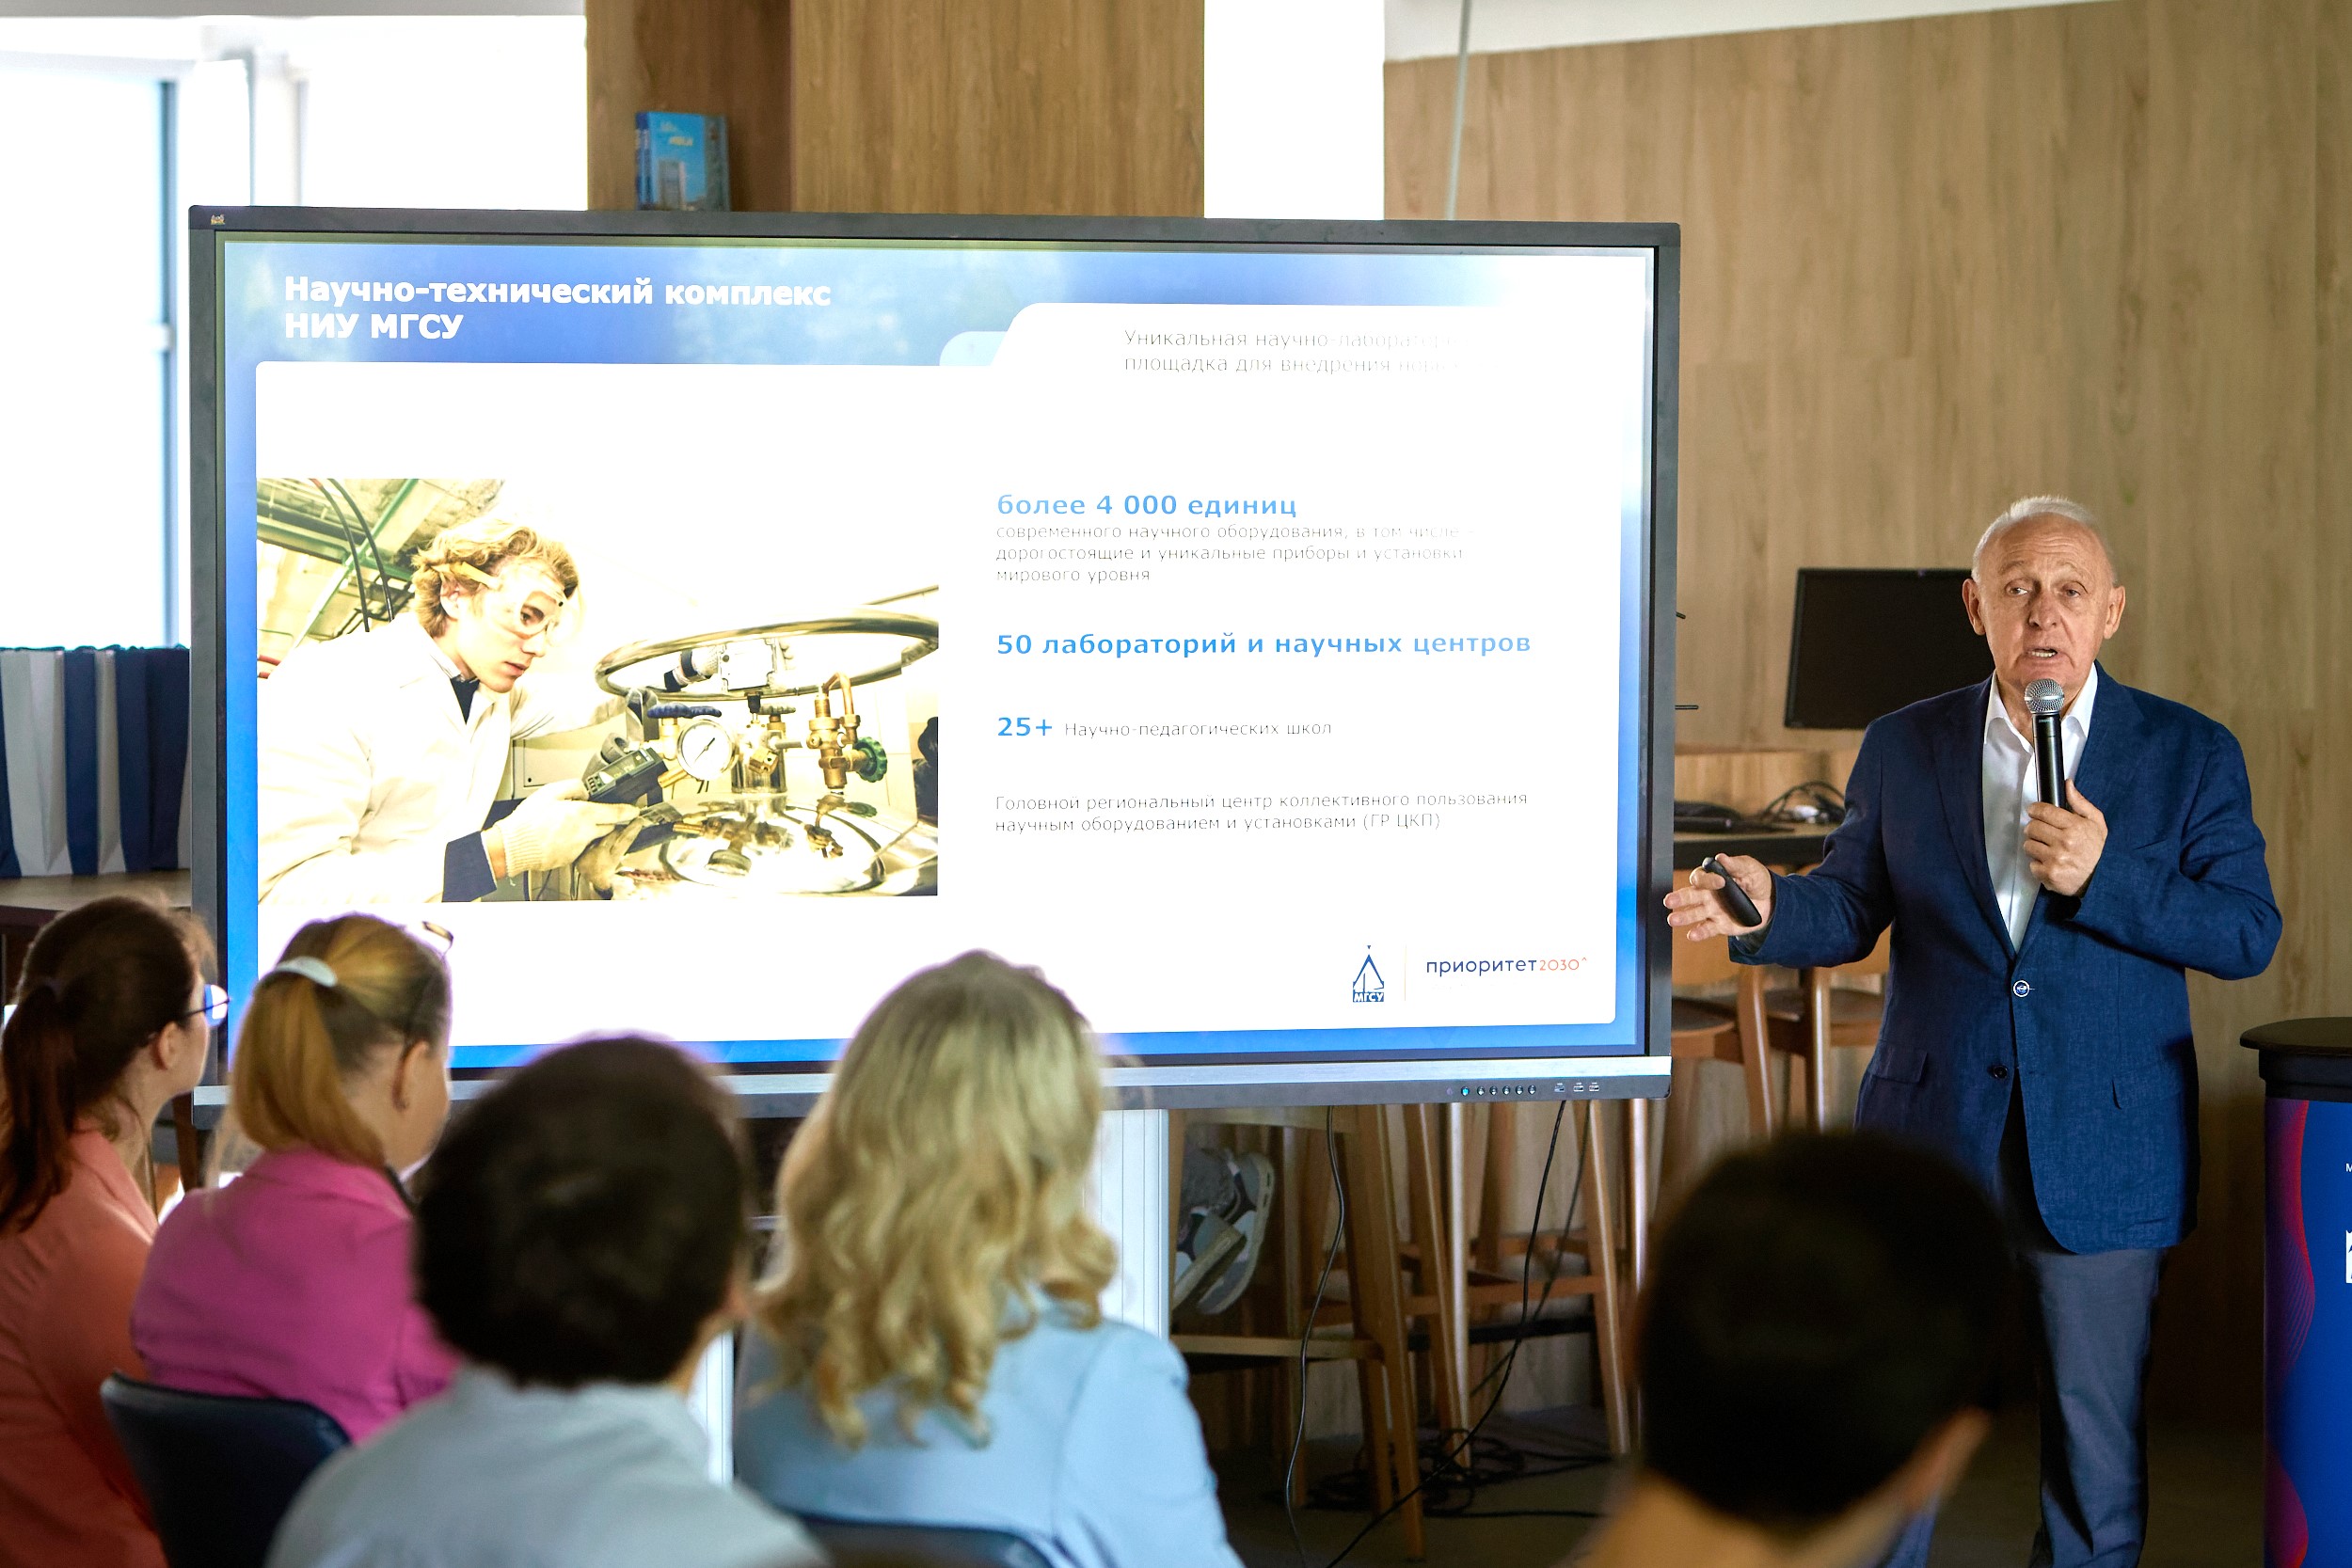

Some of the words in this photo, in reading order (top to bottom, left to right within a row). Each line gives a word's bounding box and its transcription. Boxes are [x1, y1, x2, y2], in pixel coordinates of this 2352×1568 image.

[285, 276, 653, 309] Научно-технический
[665, 284, 832, 307] комплекс
[285, 313, 359, 339] НИУ
[371, 313, 464, 340] МГСУ
[1124, 329, 1248, 347] Уникальная
[1125, 357, 1228, 374] площадка
[1235, 358, 1272, 373] для
[1281, 359, 1391, 375] внедрения
[997, 494, 1086, 515] более
[1096, 495, 1113, 515] 4
[1123, 494, 1177, 515] 000
[1187, 499, 1297, 519] единиц
[996, 527, 1121, 542] современного
[1129, 527, 1211, 541] научного
[1217, 524, 1349, 542] оборудования,
[1357, 527, 1365, 538] в
[1374, 527, 1402, 538] том
[1409, 527, 1459, 538] числе
[995, 548, 1134, 563] дорогостоящие
[1141, 548, 1151, 560] и
[1158, 548, 1266, 563] уникальные
[1273, 545, 1349, 562] приборы
[1357, 548, 1366, 560] и
[1374, 548, 1463, 562] установки
[996, 570, 1080, 585] мирового
[1088, 570, 1150, 585] уровня
[997, 633, 1032, 655] 50
[1041, 631, 1236, 659] лабораторий
[1248, 638, 1263, 654] и
[1274, 636, 1403, 658] научных
[1413, 636, 1531, 657] центров
[997, 716, 1053, 737] 25+
[1064, 721, 1279, 740] Научно-педагогических
[1287, 722, 1331, 736] школ
[995, 796, 1079, 811] Головной
[1087, 794, 1215, 813] региональный
[1222, 796, 1273, 811] центр
[1279, 795, 1409, 809] коллективного
[1417, 793, 1528, 807] пользования
[995, 819, 1073, 835] научным
[1081, 816, 1219, 834] оборудованием
[1227, 818, 1236, 830] и
[1244, 816, 1356, 832] установками
[1363, 813, 1390, 831] (ГР
[1397, 813, 1440, 831] ЦКП)
[1353, 992, 1384, 1002] МГСУ
